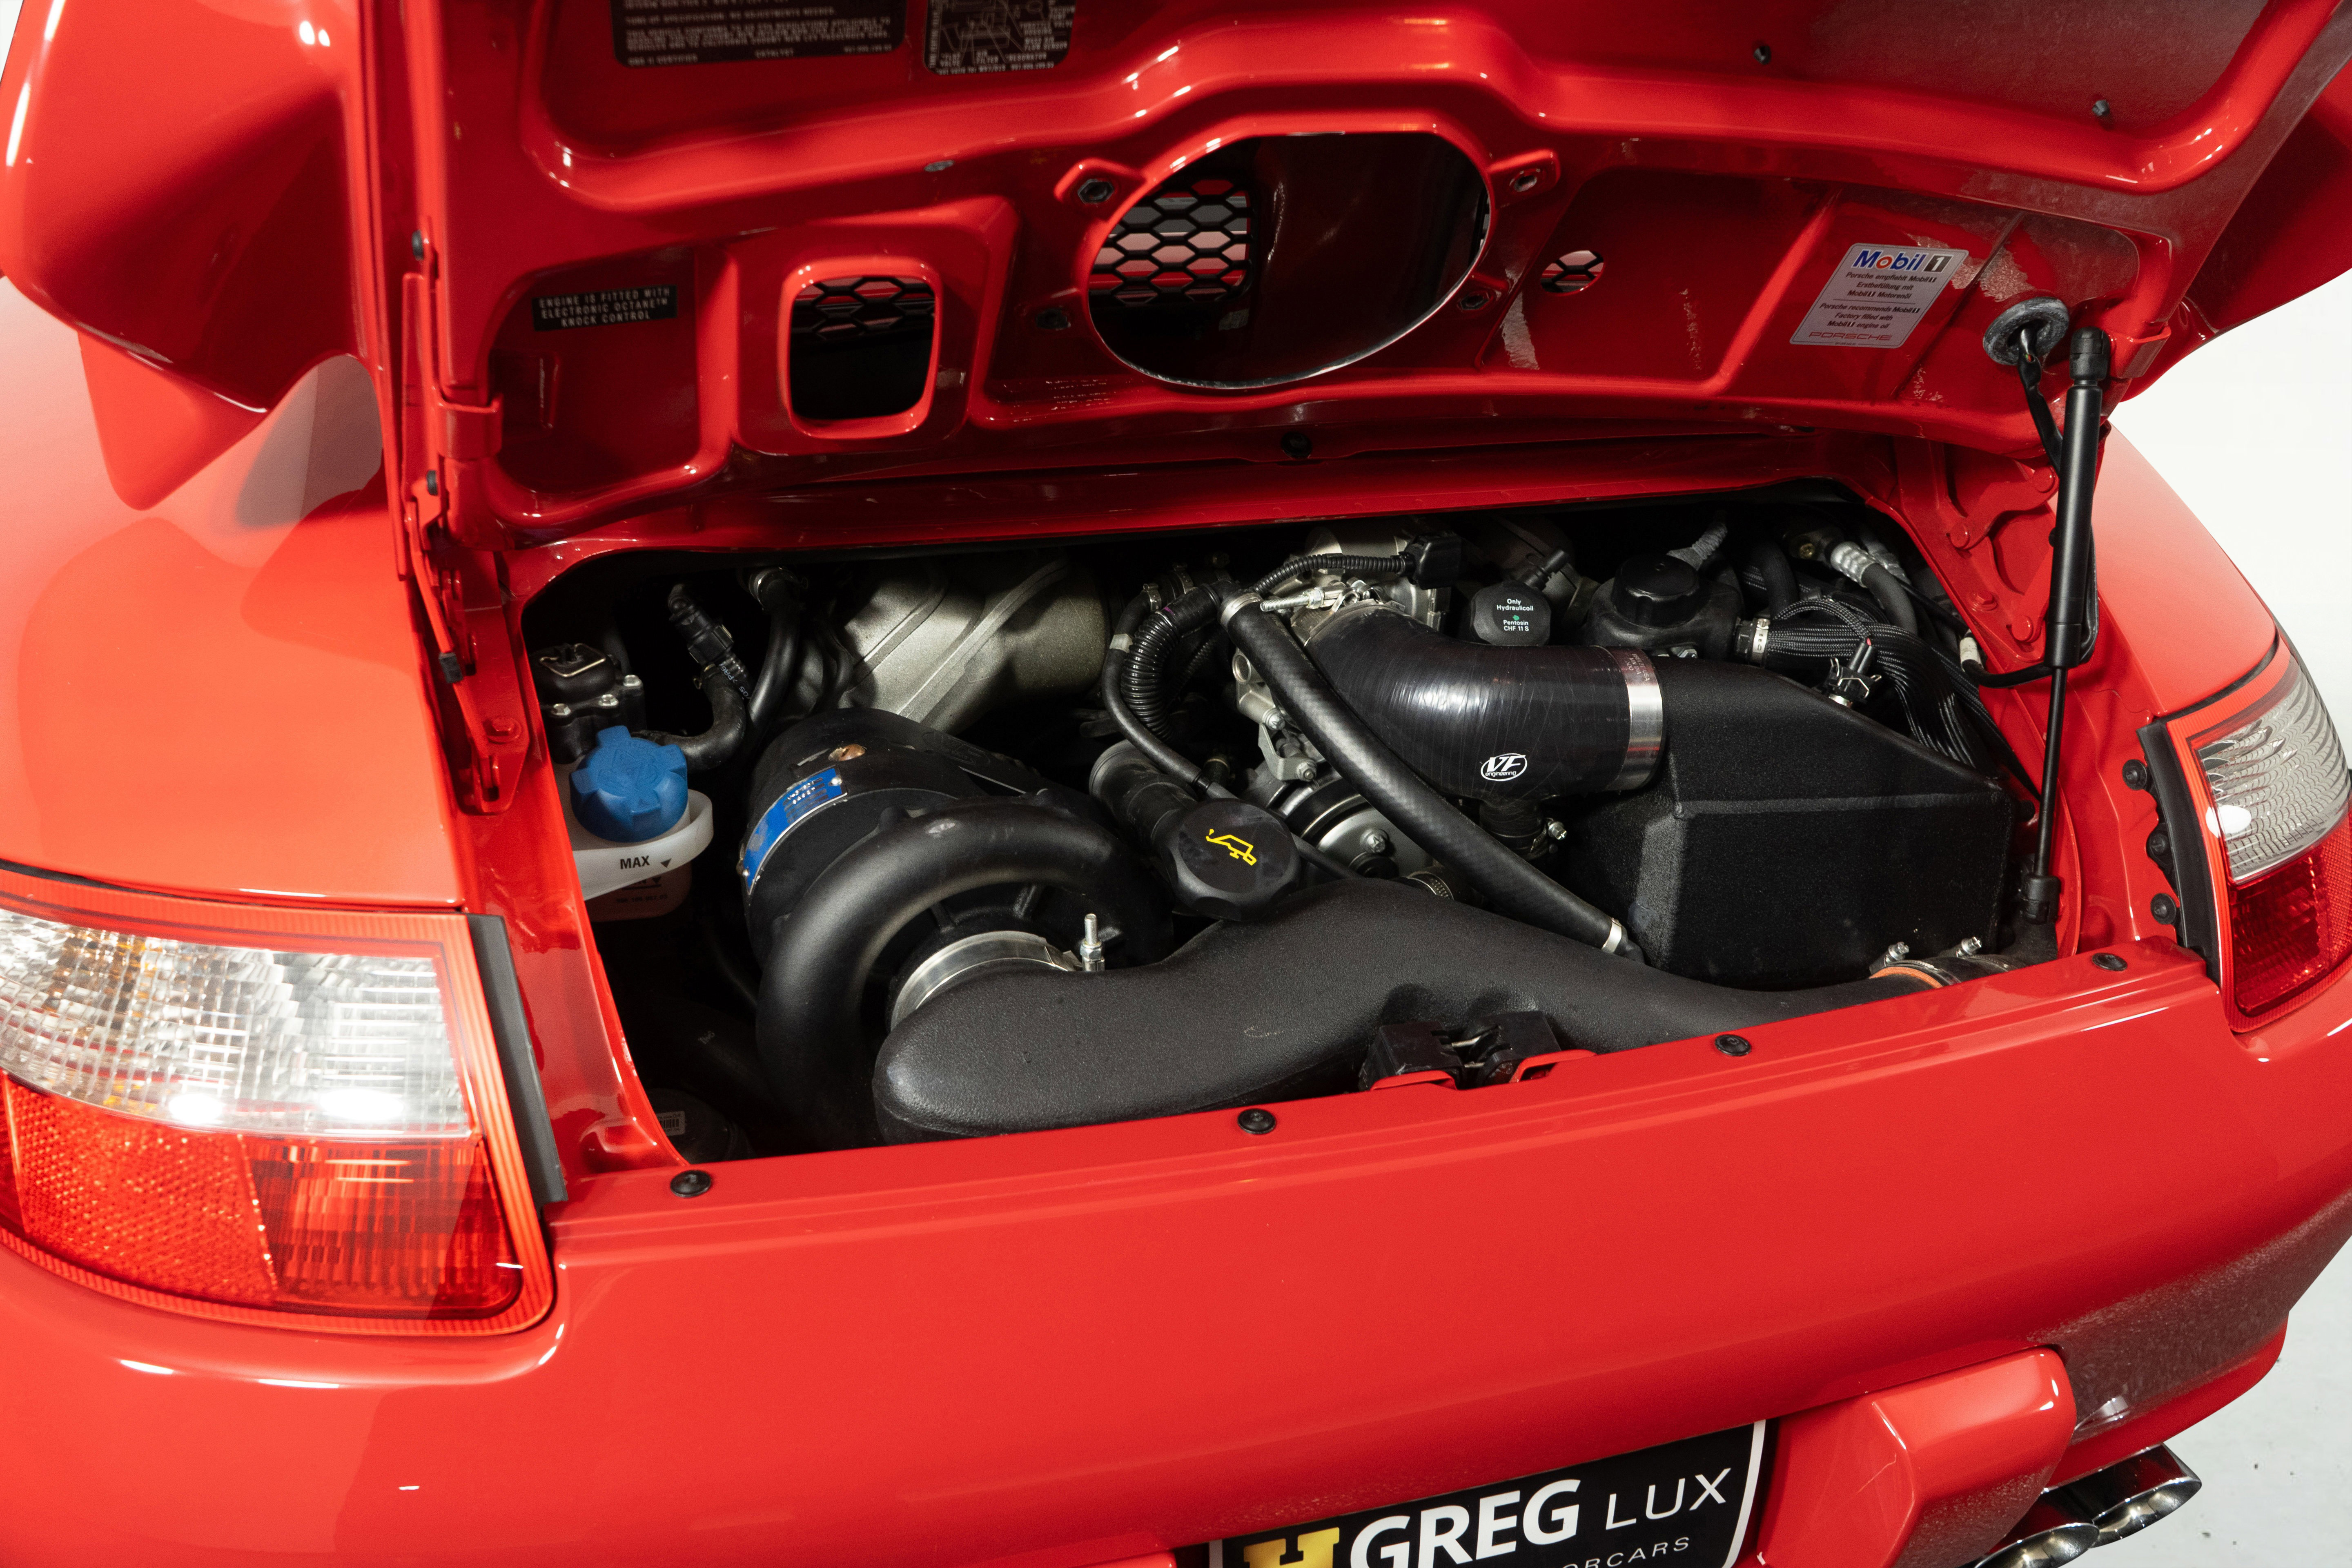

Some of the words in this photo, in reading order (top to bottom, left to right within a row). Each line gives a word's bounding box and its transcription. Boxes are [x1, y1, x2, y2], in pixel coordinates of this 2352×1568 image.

[1853, 249, 1926, 271] Mobil
[1856, 282, 1900, 290] Erstbefüllung
[539, 294, 579, 308] ENGINE
[584, 293, 595, 304] IS
[601, 290, 639, 303] FITTED
[644, 287, 670, 298] WITH
[541, 303, 609, 319] ELECTRONIC
[1849, 305, 1891, 313] recommends
[561, 315, 597, 328] KNOCK
[601, 310, 650, 323] CONTROL
[1809, 332, 1893, 341] PORSCHE
[1487, 755, 1526, 772] VF
[620, 855, 650, 870] MAX
[1606, 1468, 1731, 1530] LUX
